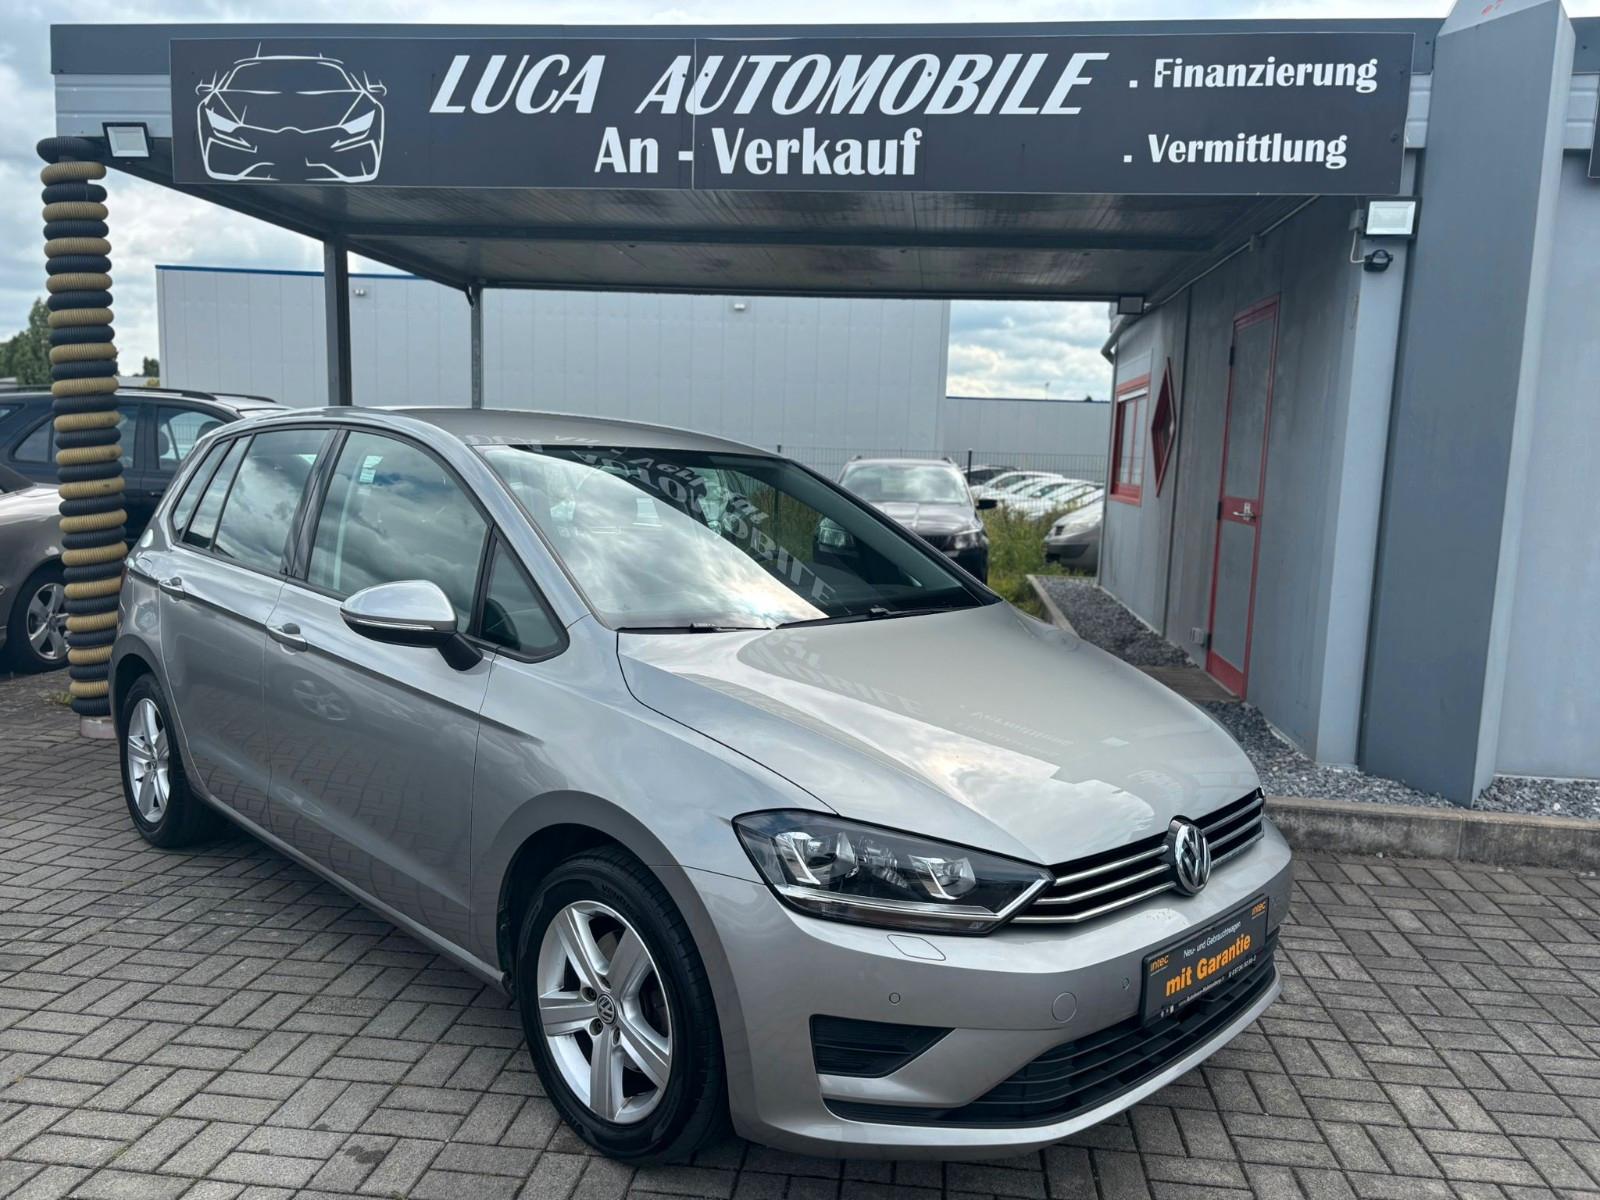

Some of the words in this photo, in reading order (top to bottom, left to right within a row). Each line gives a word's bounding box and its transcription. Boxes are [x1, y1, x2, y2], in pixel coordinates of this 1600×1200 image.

[429, 53, 606, 115] LUCA
[634, 51, 1110, 116] AUTOMOBILE
[1153, 55, 1378, 94] Finanzierung
[594, 126, 660, 174] An
[711, 127, 924, 176] Verkauf
[1147, 132, 1349, 170] Vermittlung
[1165, 965, 1193, 997] mit
[1196, 933, 1252, 980] Garantie
